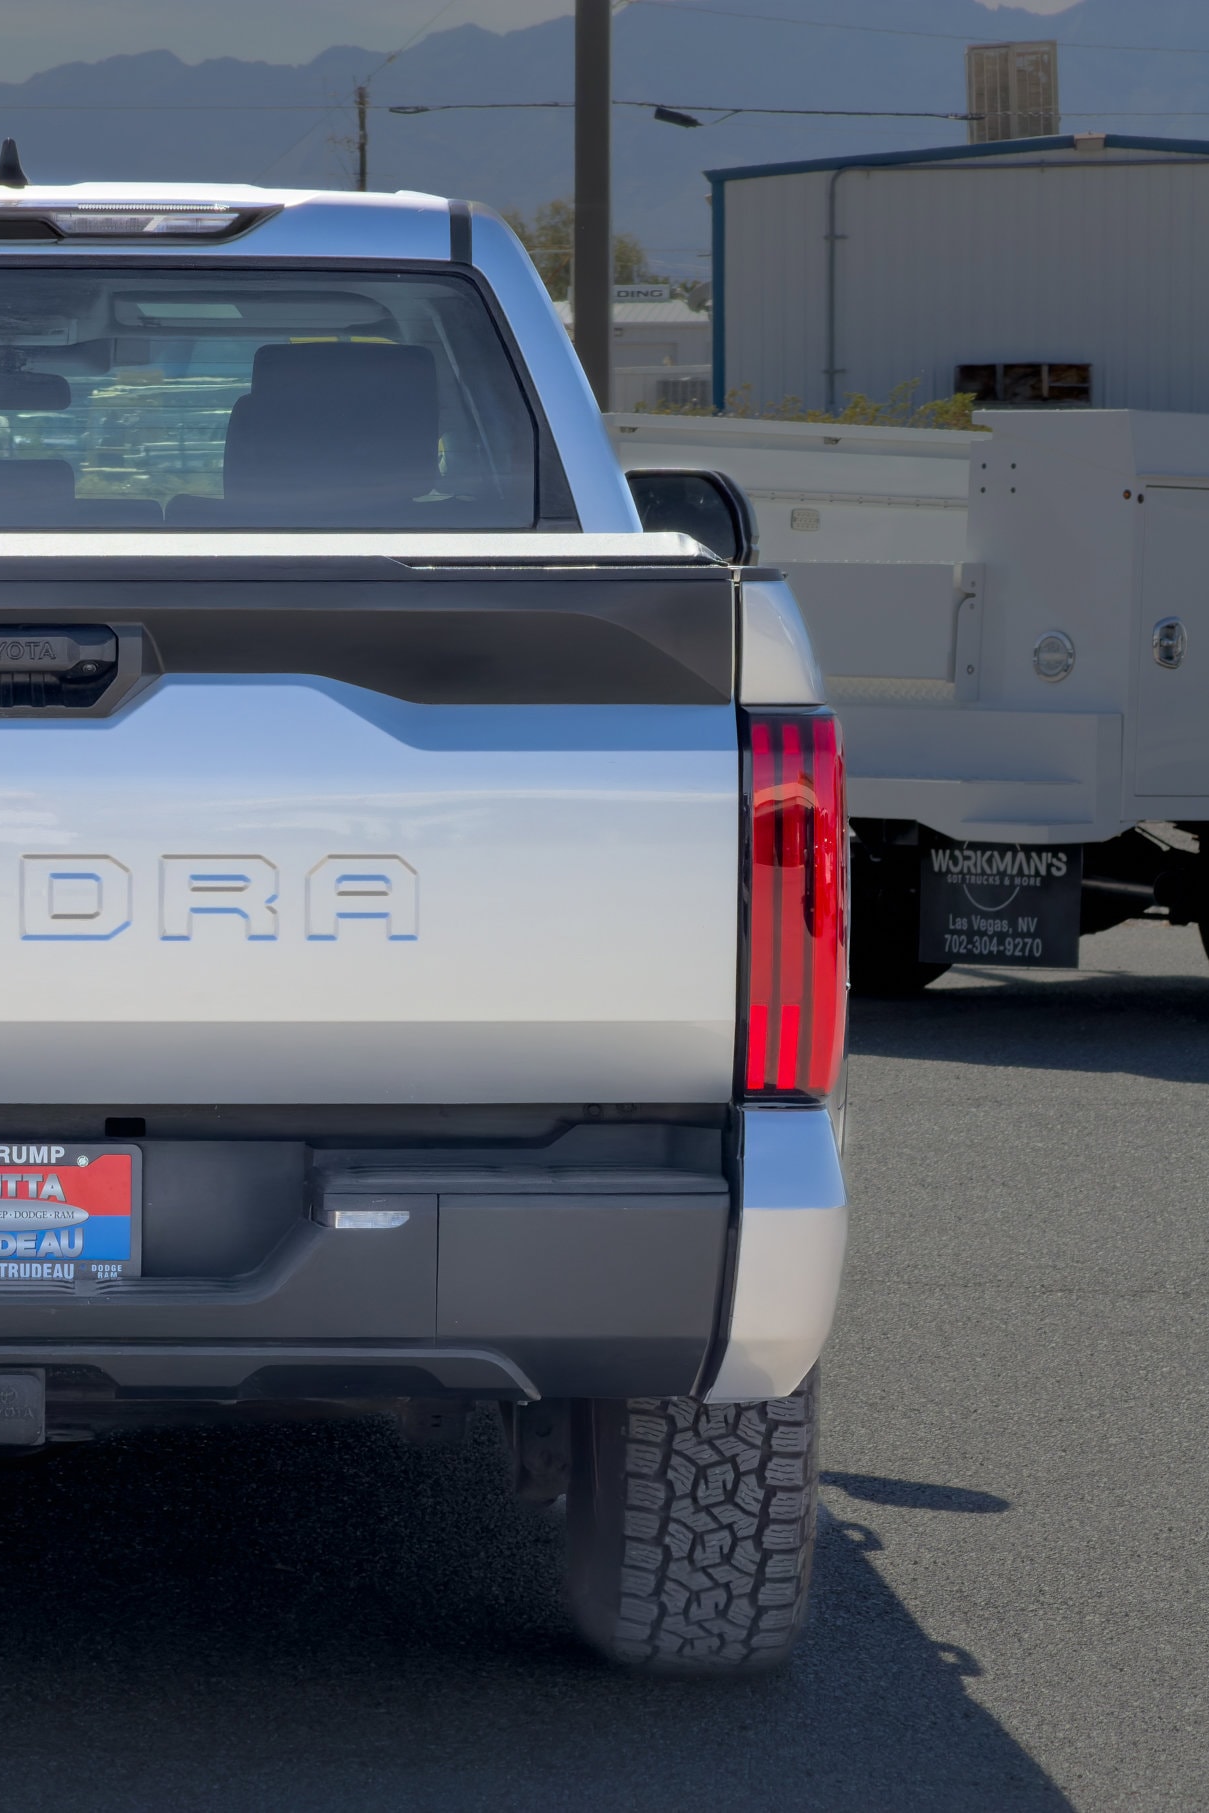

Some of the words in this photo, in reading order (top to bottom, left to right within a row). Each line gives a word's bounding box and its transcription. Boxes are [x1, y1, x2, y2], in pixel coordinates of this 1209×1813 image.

[930, 848, 1068, 877] WORKMAN'S
[965, 875, 1000, 885] TRUCKS
[1014, 876, 1042, 887] MORE
[948, 913, 968, 930] Las
[971, 914, 1013, 935] Vegas,
[1017, 916, 1038, 933] NV
[944, 934, 1042, 957] 702-304-9270
[14, 1210, 48, 1220] DODGE
[54, 1210, 75, 1220] RAM
[91, 1264, 123, 1273] DODGE
[97, 1271, 119, 1279] RAM
